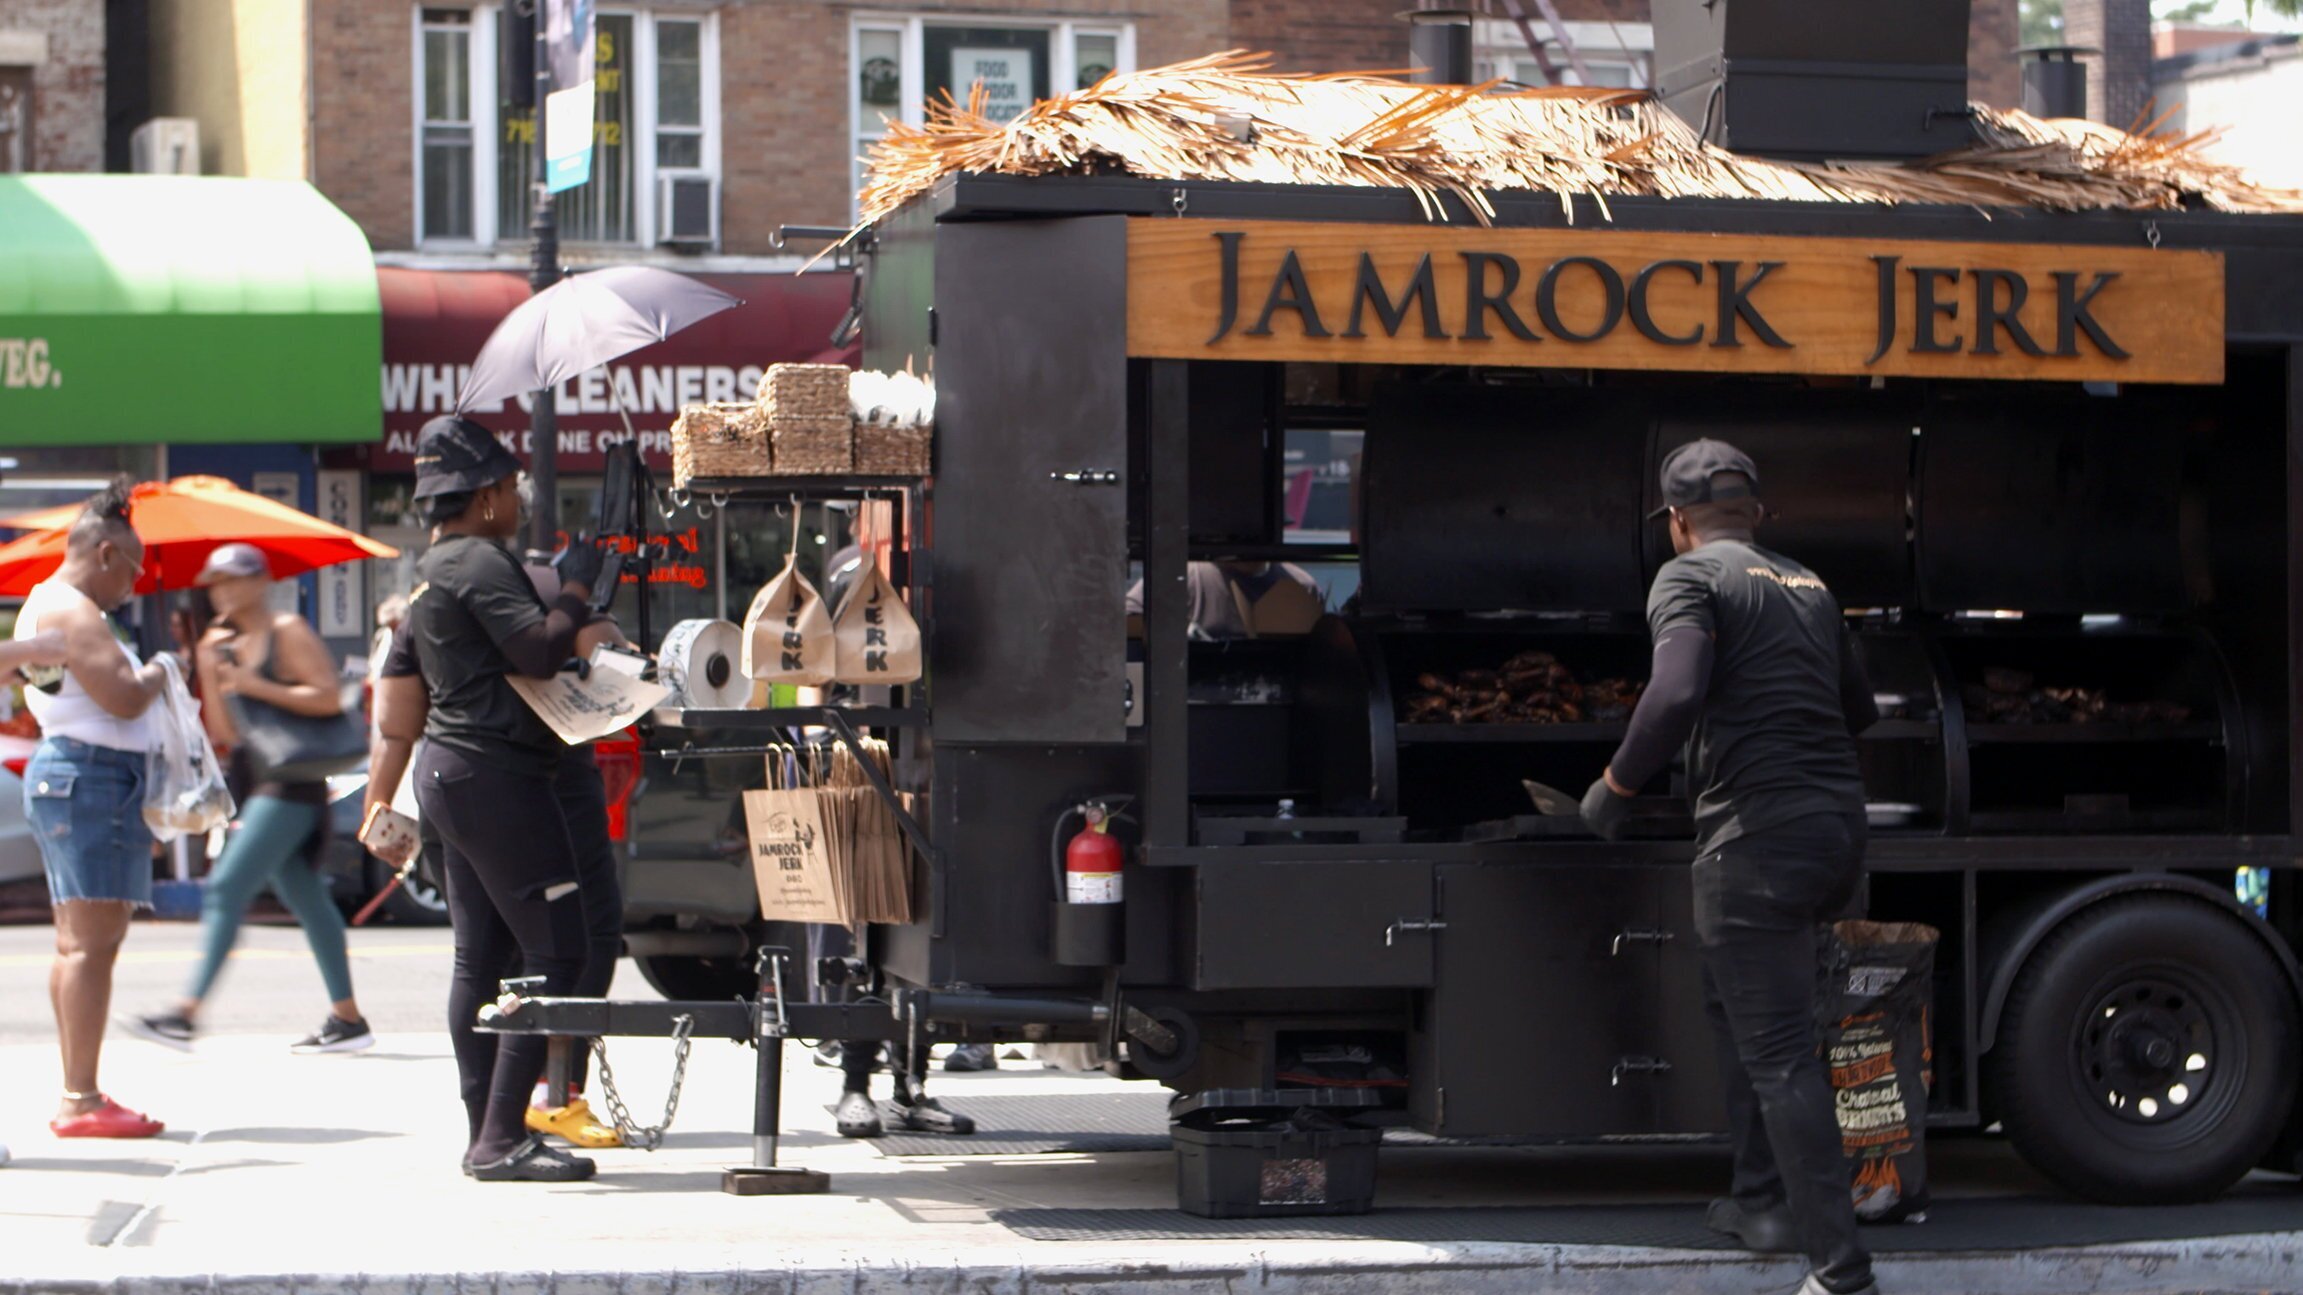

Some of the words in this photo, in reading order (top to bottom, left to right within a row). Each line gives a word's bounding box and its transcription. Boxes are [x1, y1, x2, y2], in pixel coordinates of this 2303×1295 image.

[1205, 231, 1796, 349] JAMROCK
[1865, 254, 2132, 367] JERK
[0, 338, 62, 388] EG.
[759, 843, 803, 857] JAMROCK
[779, 857, 803, 871] JERK
